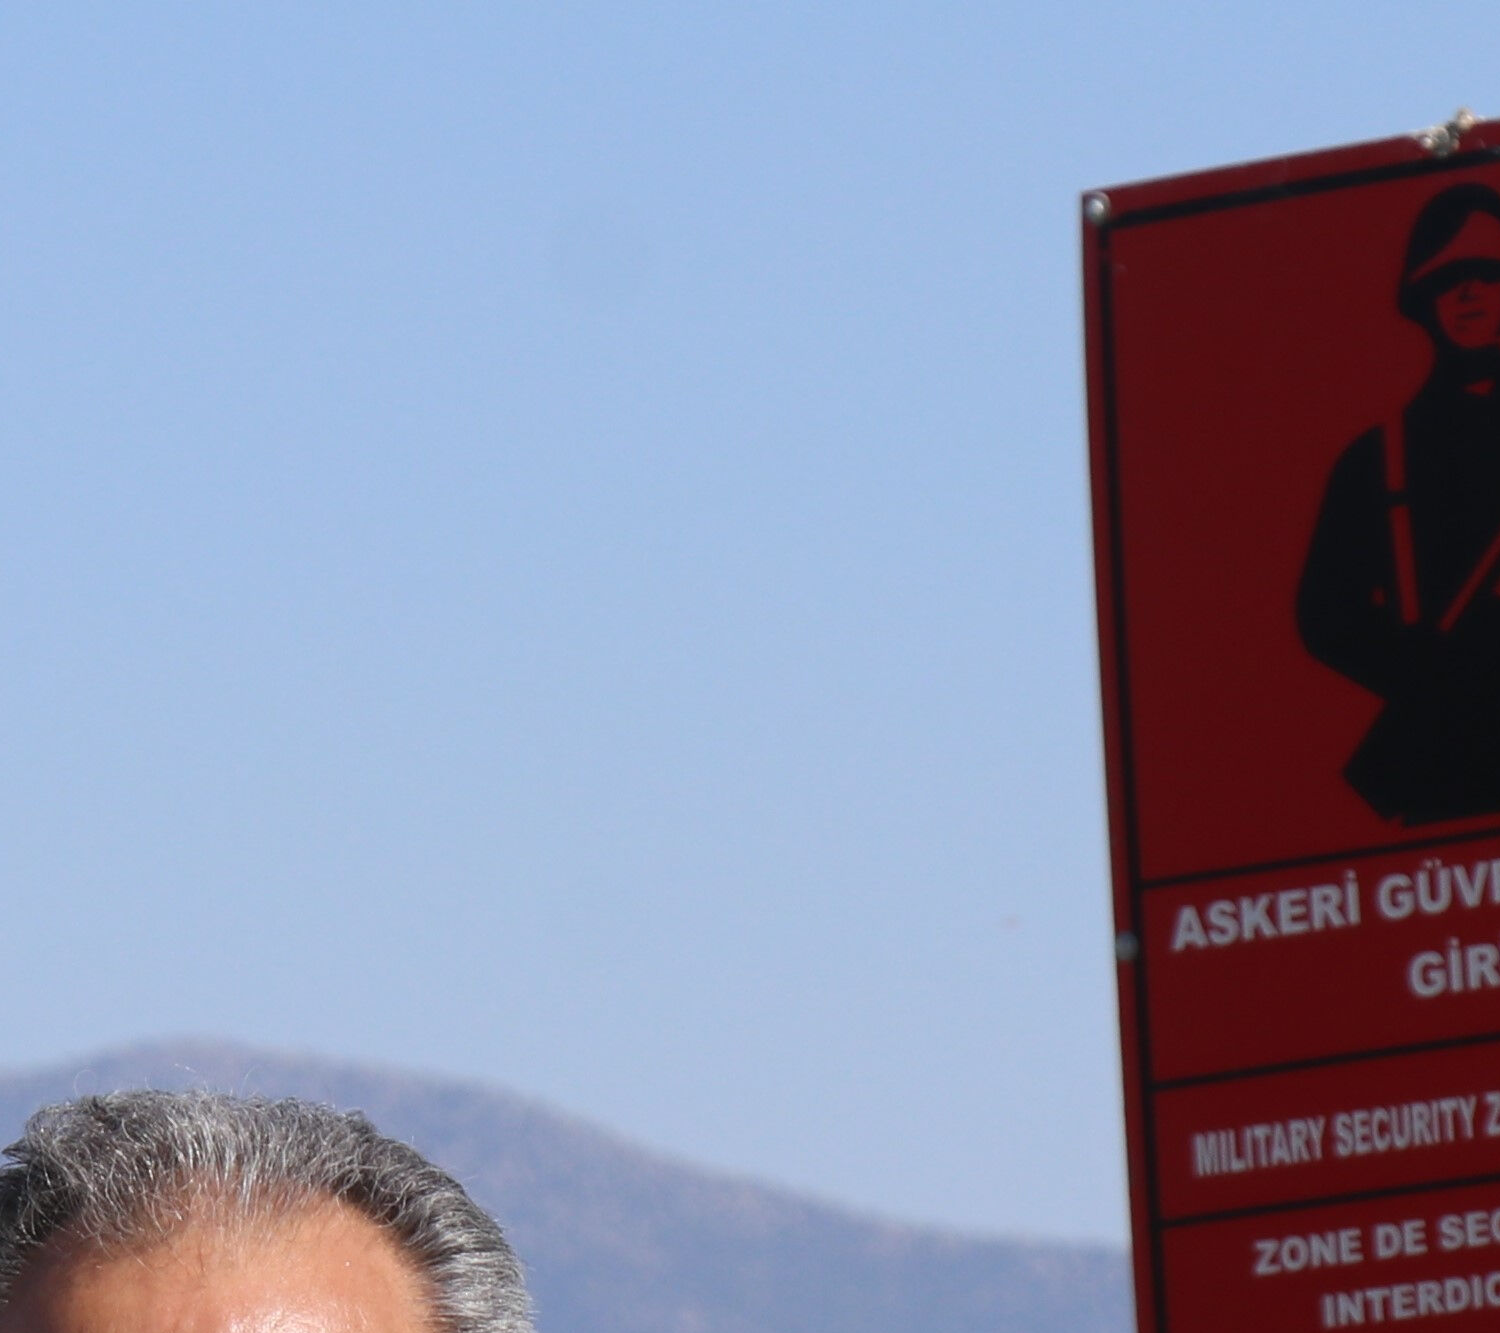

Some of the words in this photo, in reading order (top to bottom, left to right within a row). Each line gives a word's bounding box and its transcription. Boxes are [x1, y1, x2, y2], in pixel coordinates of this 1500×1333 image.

[1172, 869, 1361, 951] ASKERİ
[1193, 1118, 1325, 1177] MILITARY
[1334, 1096, 1476, 1157] SECURITY
[1254, 1228, 1363, 1276] ZONE
[1375, 1220, 1427, 1259] DE
